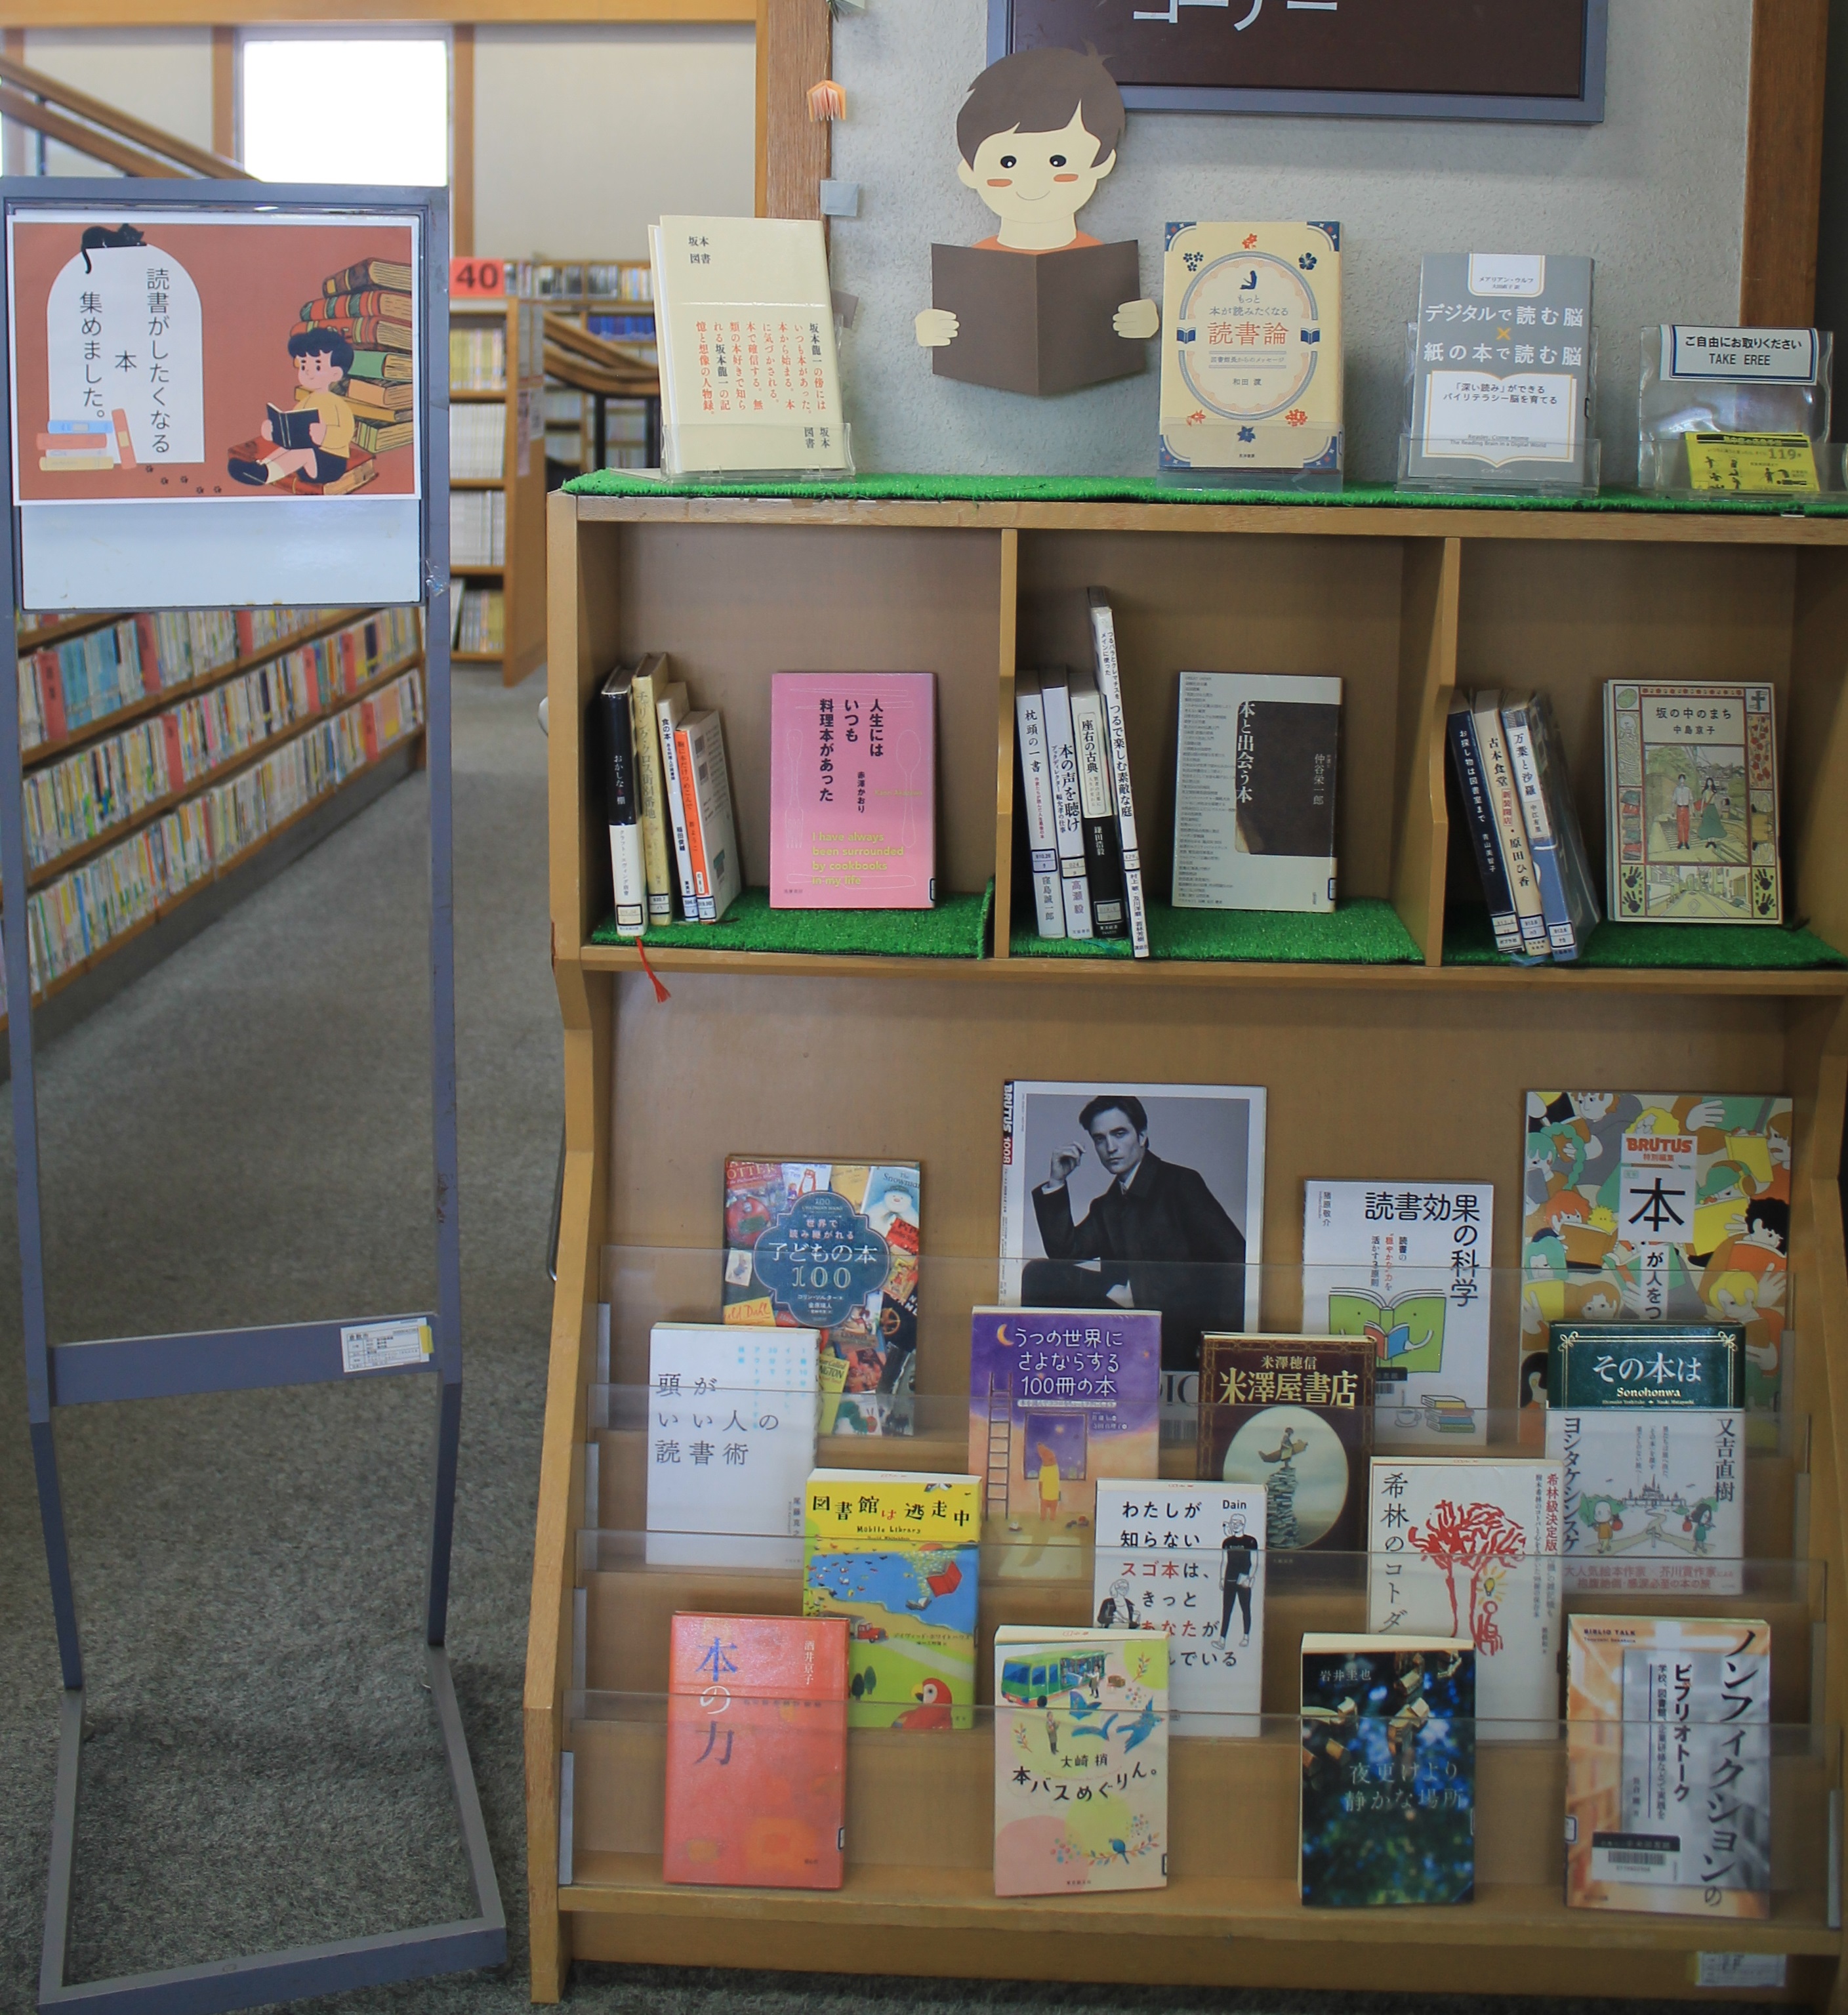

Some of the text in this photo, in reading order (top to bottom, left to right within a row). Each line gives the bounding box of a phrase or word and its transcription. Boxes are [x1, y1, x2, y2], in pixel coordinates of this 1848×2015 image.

[688, 236, 709, 247] 坂本
[689, 253, 711, 264] 図書
[456, 263, 499, 289] 40
[1209, 306, 1288, 316] 本が読みたくなる
[1237, 295, 1260, 304] もっと
[1425, 304, 1583, 327] デジタルで読む脳
[1208, 322, 1288, 346] 読書論
[1685, 336, 1801, 349] ご自由にお取りください
[79, 291, 104, 418] 集めました。
[115, 350, 137, 372] 本
[146, 267, 171, 453] 読書がしたくなる
[763, 323, 779, 403] に気づかされる。
[1424, 343, 1582, 366] 紙の本で読む脳
[1710, 354, 1771, 365] TAKE EREE
[696, 322, 714, 415] 憶と想像の人物録。
[714, 322, 731, 411] れる坂本龍一の記
[729, 322, 746, 411] 類の本好きで知ら
[795, 324, 811, 414] いつも本があった。
[810, 323, 826, 410] 坂本龍一の傍には
[1444, 394, 1557, 404] バイリテラシー脳を育てる
[1454, 383, 1545, 394] 「深い読み」ができる
[804, 427, 815, 448] 図書
[820, 427, 830, 447] 坂本
[1769, 448, 1796, 459] 119
[845, 699, 859, 742] いつも
[1656, 707, 1731, 720] 坂の中のまち
[661, 718, 671, 739] 食の本
[870, 699, 884, 757] 人生には
[1673, 726, 1715, 735] 中島京子
[819, 699, 834, 802] 料理本があった
[1025, 709, 1042, 773] 枕頭の一書
[1081, 720, 1099, 773] 座右の古典
[1236, 701, 1256, 803] 本と出会う本
[1110, 704, 1133, 818] つるで楽しむ素敵な庭
[1489, 737, 1508, 787] 古本食堂
[1514, 733, 1536, 796] 万葉と沙羅
[1058, 743, 1080, 832] 本の声を聴け
[1313, 753, 1325, 805] 仲谷栄一郎
[857, 772, 865, 813] 赤澤かおり
[819, 832, 844, 841] have
[848, 833, 884, 843] always
[813, 846, 903, 856] been surrounded
[1509, 837, 1530, 886] 原田ひ香
[813, 862, 888, 871] by cookbooks
[813, 875, 861, 886] in my life
[1071, 880, 1083, 900] 高瀬
[1003, 1084, 1014, 1132] BRUTUS
[1626, 1136, 1693, 1153] BRUTUS
[1643, 1153, 1675, 1162] 特別編集
[1628, 1177, 1685, 1232] 本
[789, 1230, 854, 1239] 読み継がれる
[806, 1219, 838, 1228] 世界で
[768, 1243, 878, 1264] 子どもの本
[1399, 1236, 1408, 1261] 読書の
[792, 1266, 852, 1289] 100
[1015, 1328, 1123, 1348] うつの世界に
[1017, 1352, 1120, 1373] さよならする
[1261, 1356, 1318, 1370] 米澤穂信
[1592, 1352, 1702, 1384] その本は
[656, 1373, 716, 1396] 頭が
[1021, 1375, 1117, 1396] 100冊の本
[1218, 1367, 1358, 1409] 米澤屋書店
[1616, 1387, 1681, 1398] Sonohonwa
[659, 1409, 779, 1431] いい人の
[655, 1439, 749, 1466] 読書術
[1715, 1418, 1735, 1502] 又吉直樹
[1563, 1417, 1582, 1554] ヨシタケシンスケ
[813, 1495, 970, 1527] 図書館は逃走中
[1122, 1501, 1202, 1519] わたしが
[1222, 1499, 1247, 1510] Dain
[890, 1526, 921, 1534] Library
[1120, 1531, 1201, 1548] 知らない
[1121, 1561, 1210, 1577] スゴ本は、
[1143, 1590, 1197, 1608] きっと
[804, 1640, 815, 1685] 酒井京子
[1319, 1670, 1372, 1682] 岩井圭也
[695, 1637, 738, 1765] 本の力
[1673, 1664, 1692, 1802] ビブリオトーク
[1061, 1753, 1108, 1768] 大崎 梢
[1700, 1630, 1759, 1907] ノンフィクションの
[1012, 1761, 1157, 1802] 本バスめぐりん。
[1349, 1761, 1457, 1785] 夜更けより
[1345, 1789, 1468, 1812] 静かな場所
